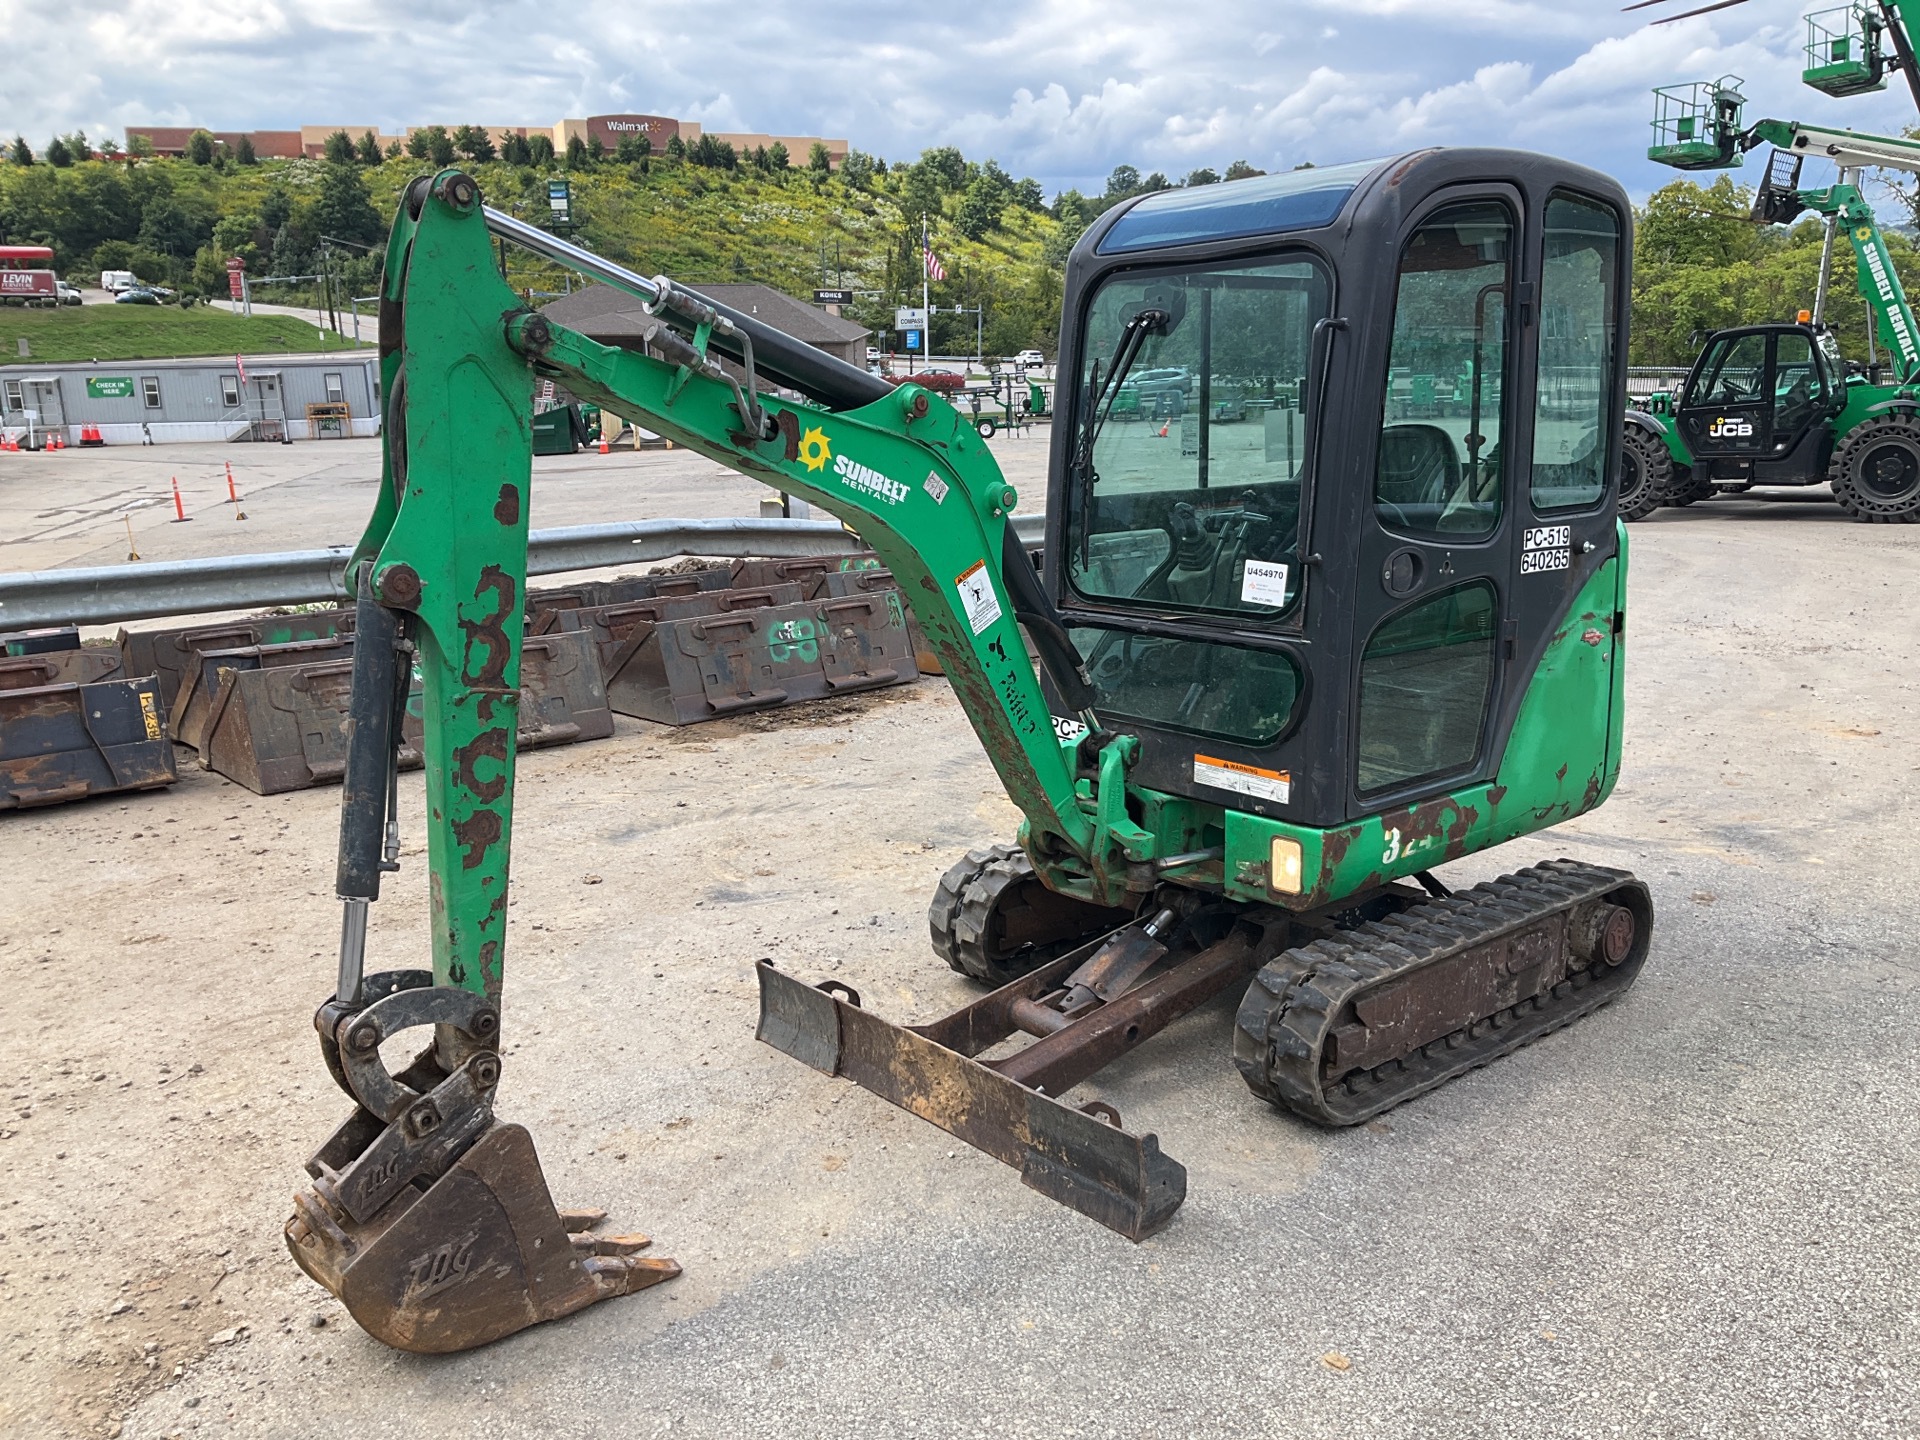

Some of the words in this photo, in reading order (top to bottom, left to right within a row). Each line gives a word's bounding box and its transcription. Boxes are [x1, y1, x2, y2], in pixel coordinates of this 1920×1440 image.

[607, 121, 649, 132] Walmart
[3, 274, 33, 283] LEVIN
[1863, 242, 1895, 302] SUNBELT
[1886, 303, 1919, 363] RENTALS
[1710, 424, 1753, 437] JCB
[833, 454, 911, 502] SUNBELT
[841, 476, 896, 506] RENTALS
[1524, 527, 1569, 548] PC-519
[1521, 550, 1569, 572] 640265
[1247, 567, 1284, 580] U454970
[1229, 763, 1258, 775] WARNING
